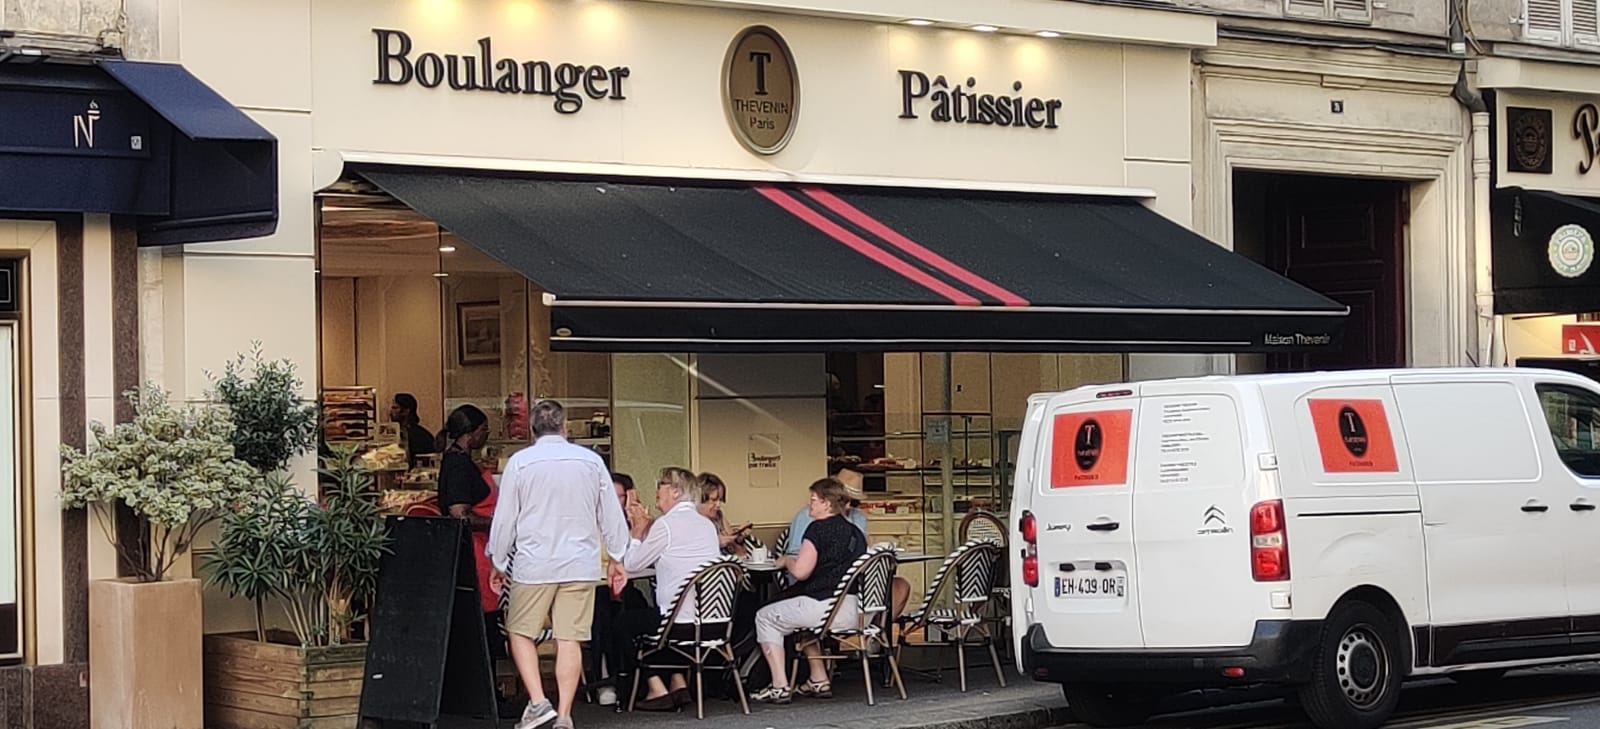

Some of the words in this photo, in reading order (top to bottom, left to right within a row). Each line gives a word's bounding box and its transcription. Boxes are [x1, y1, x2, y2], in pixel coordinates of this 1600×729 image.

[371, 28, 630, 114] Boulanger
[749, 51, 771, 96] T
[734, 98, 789, 114] THEVENIN
[749, 116, 775, 130] Paris
[897, 69, 1062, 129] Pâtissier
[1572, 103, 1600, 175] P
